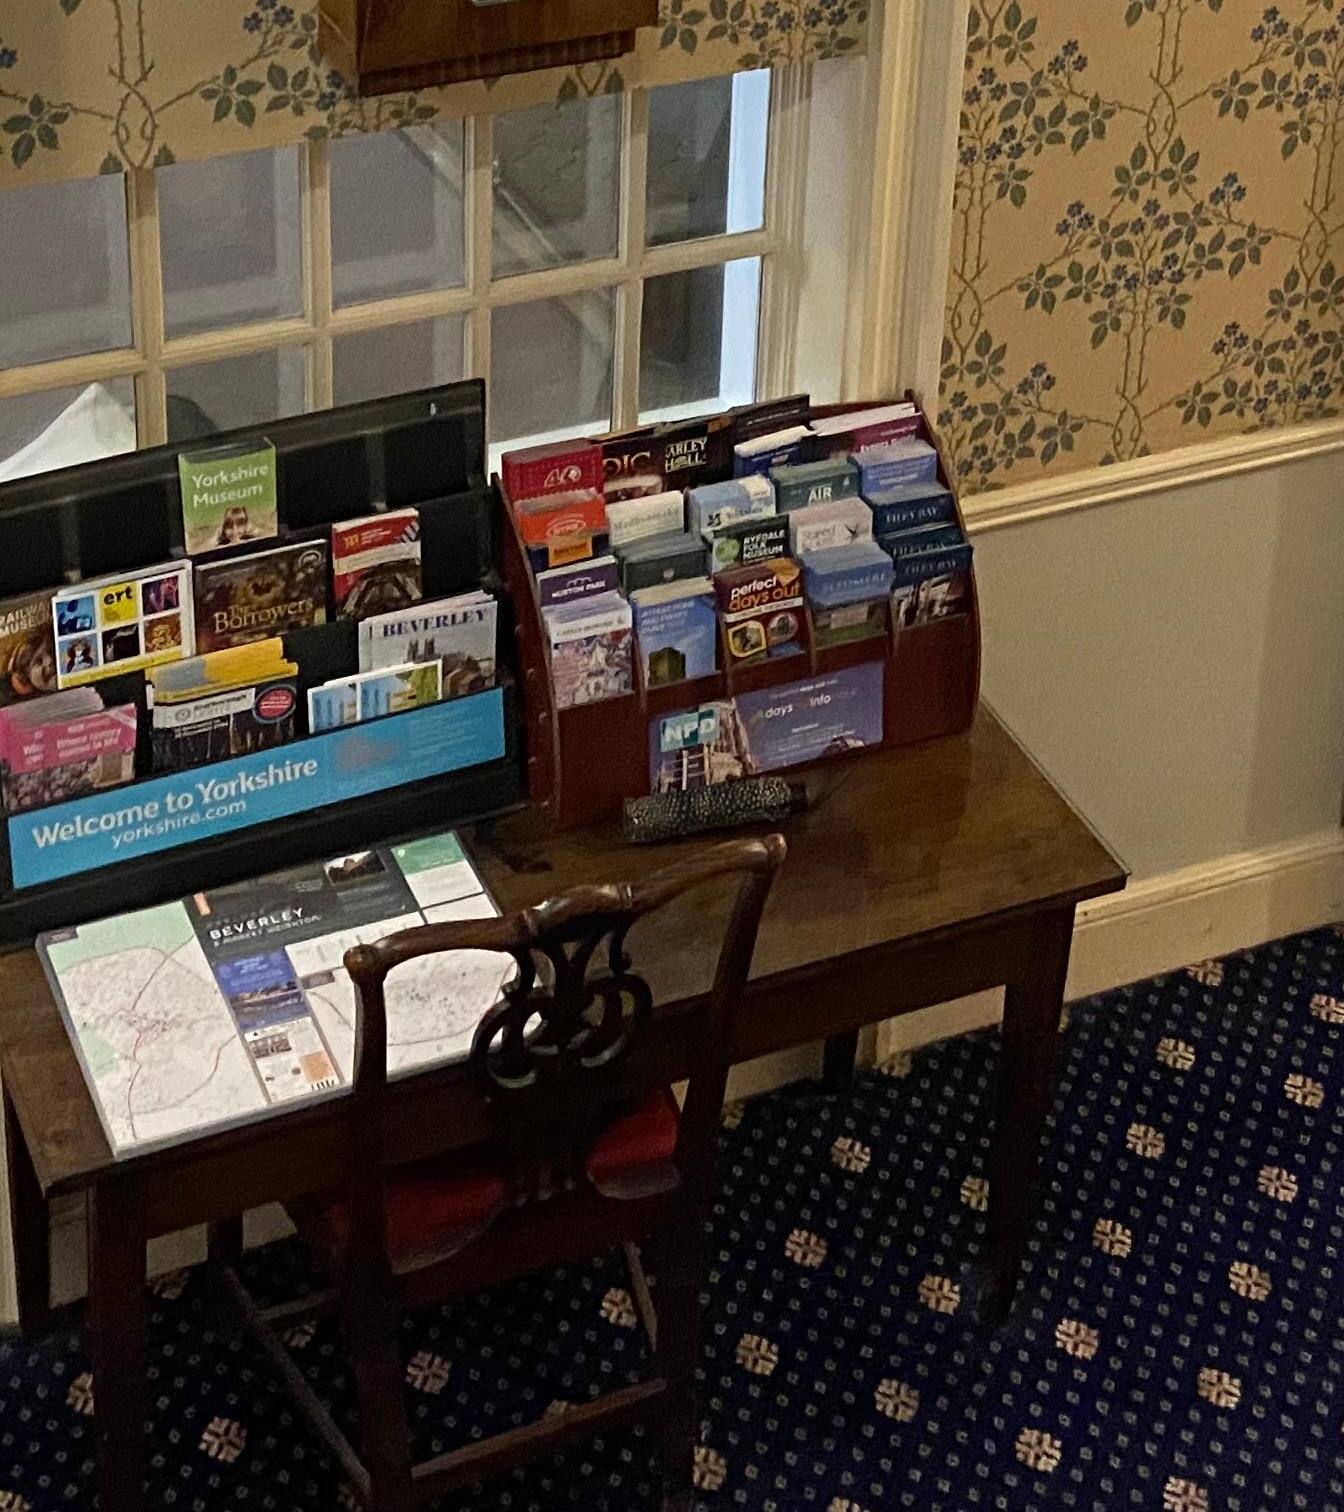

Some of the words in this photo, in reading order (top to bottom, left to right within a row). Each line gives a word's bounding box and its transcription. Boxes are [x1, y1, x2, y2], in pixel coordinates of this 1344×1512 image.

[192, 463, 269, 489] Yorkshire
[192, 484, 264, 508] Museum
[808, 486, 833, 503] AIR
[743, 544, 784, 560] MUSEUM
[103, 587, 133, 606] ert
[728, 590, 770, 613] days
[772, 581, 801, 601] out
[730, 574, 778, 601] perfect
[213, 598, 314, 633] Borrowers
[383, 608, 487, 637] BEVERLEY
[32, 799, 160, 849] Welcome
[166, 790, 194, 814] to
[195, 757, 318, 805] Yorkshire
[111, 798, 247, 849] yorkshire.com
[209, 906, 304, 940] BEVERLEY
